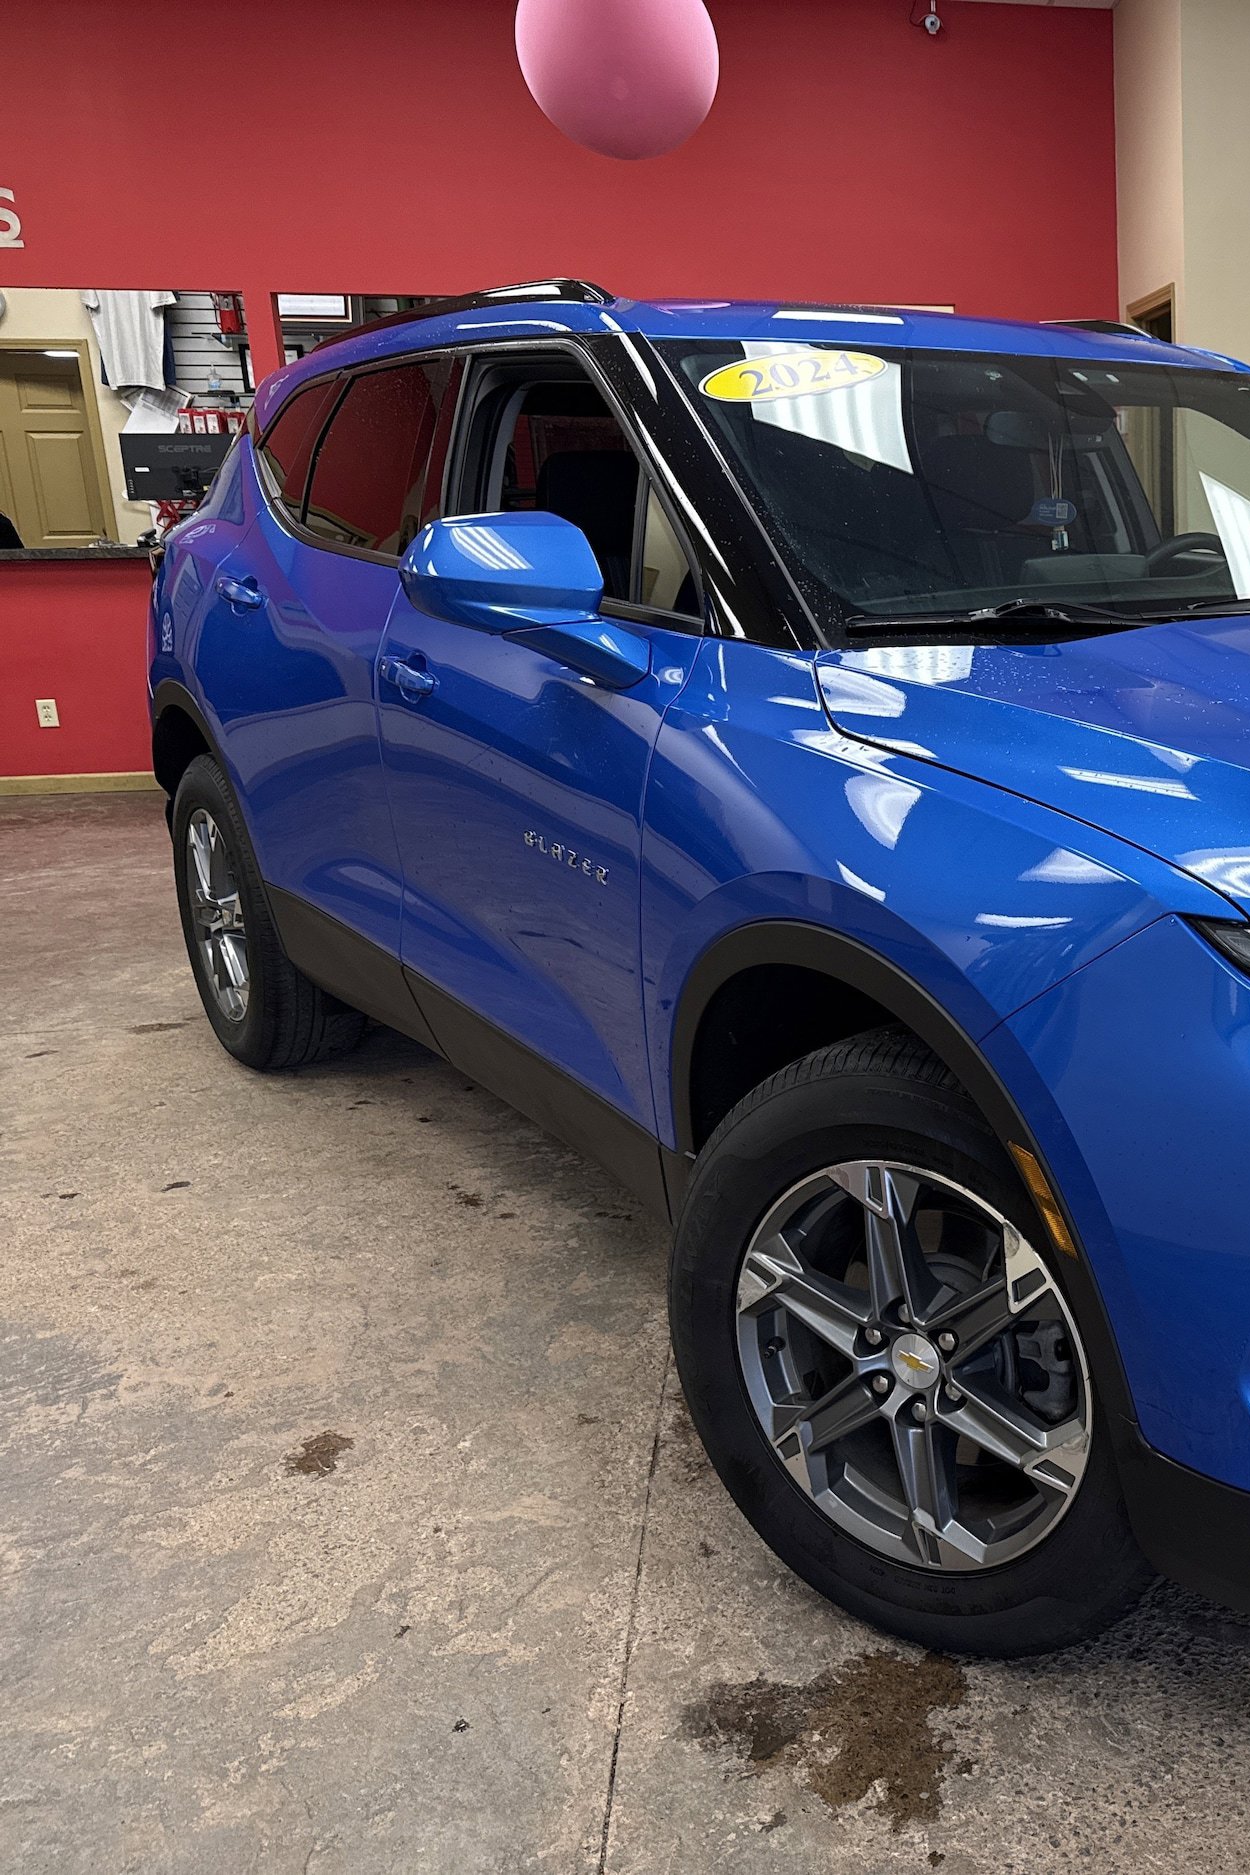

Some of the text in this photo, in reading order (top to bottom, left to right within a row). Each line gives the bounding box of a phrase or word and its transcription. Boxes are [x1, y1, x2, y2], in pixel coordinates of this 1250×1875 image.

[739, 352, 859, 397] 2024
[157, 445, 212, 453] SCEPTRE
[523, 830, 610, 886] BLAZER
